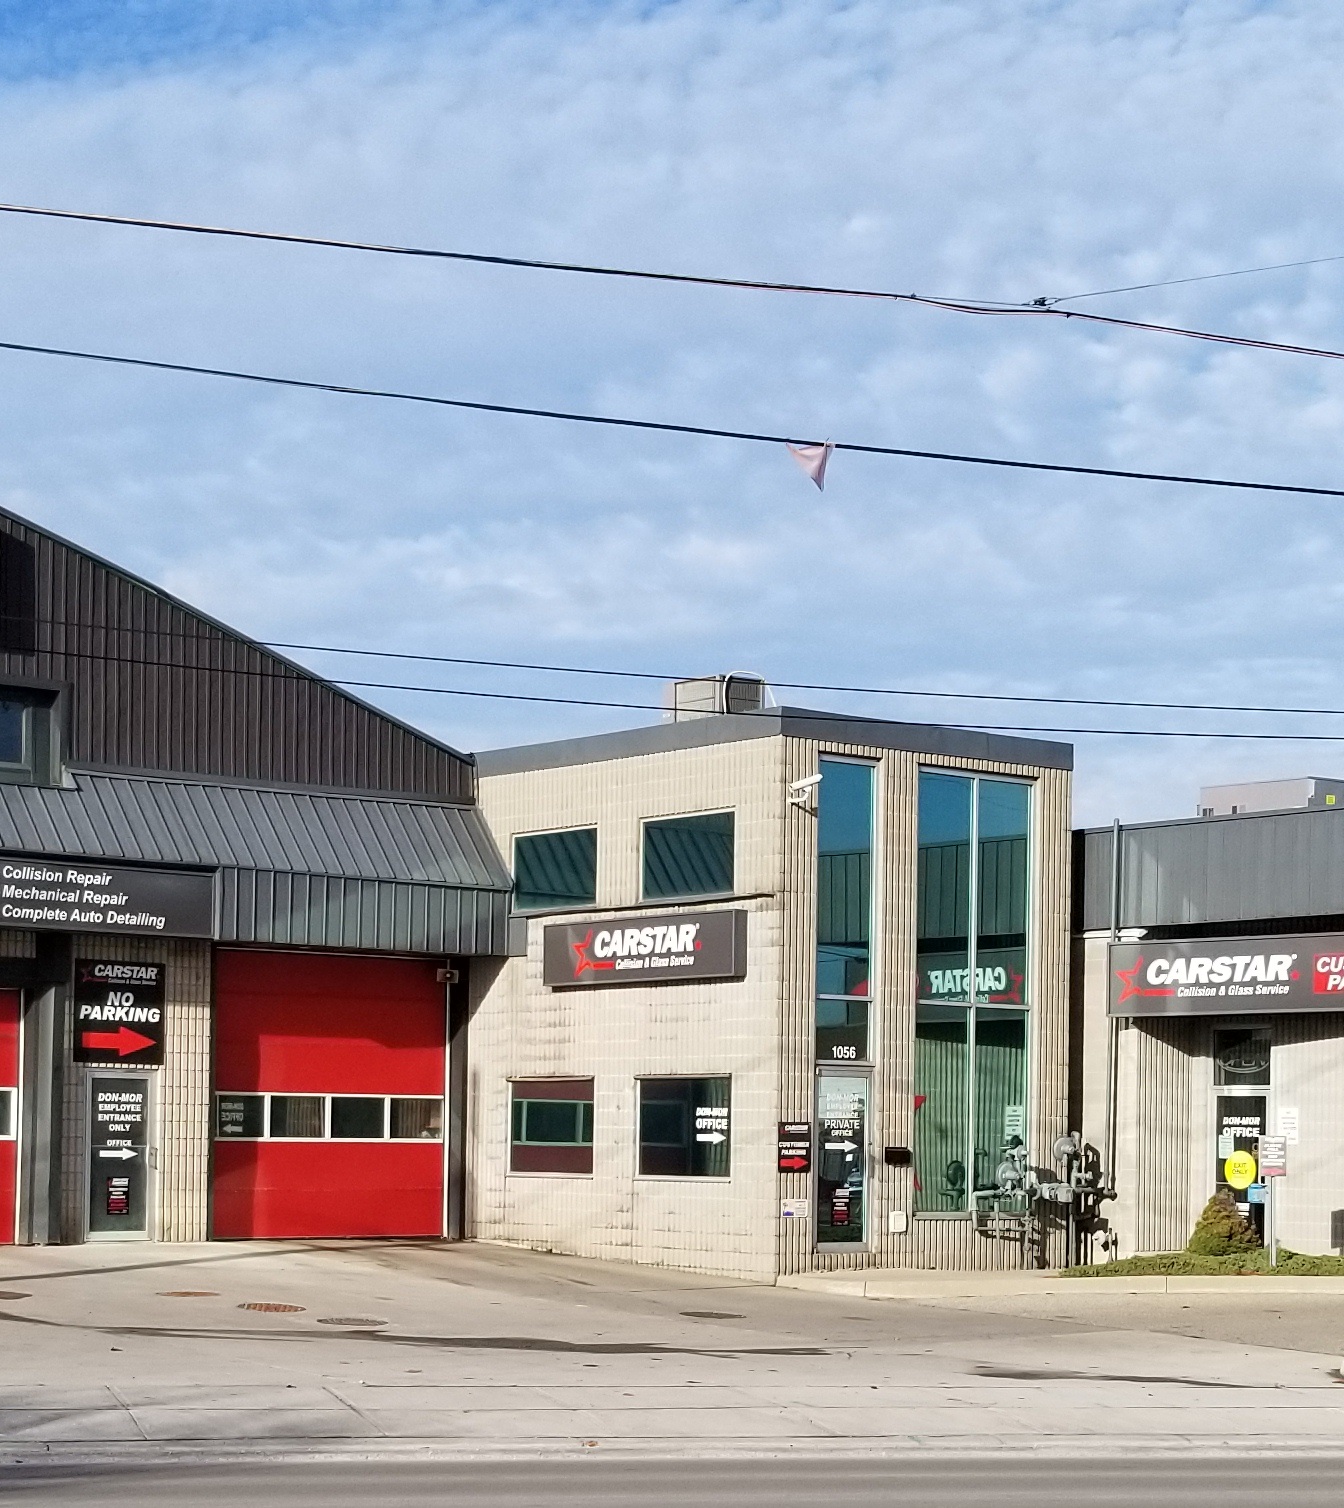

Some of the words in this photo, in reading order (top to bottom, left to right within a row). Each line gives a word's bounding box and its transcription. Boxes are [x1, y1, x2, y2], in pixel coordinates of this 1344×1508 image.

[2, 865, 63, 883] Collision
[66, 869, 113, 888] Repair
[2, 884, 81, 904] Mechanical
[82, 890, 129, 908] Repair
[2, 904, 68, 923] Complete
[70, 908, 104, 924] Auto
[106, 910, 166, 930] Detailing
[594, 923, 697, 958] CARSTAR
[94, 964, 158, 980] CARSTAR
[1146, 954, 1293, 985] CARSTAR
[1177, 986, 1216, 998] Collision
[1218, 986, 1226, 996] &
[1227, 985, 1253, 996] Glass
[1255, 983, 1290, 995] Service
[106, 991, 135, 1008] NO
[79, 1004, 161, 1023] PARKING
[831, 1046, 857, 1059] 1056
[97, 1092, 143, 1103] DON-MOR
[98, 1103, 142, 1112] EMPLOYEE
[97, 1113, 142, 1122] ENTRANCE
[696, 1118, 728, 1130] OFFICE
[824, 1119, 860, 1130] PRIVATE
[108, 1123, 132, 1132] ONLY
[1222, 1126, 1261, 1138] OFFICE
